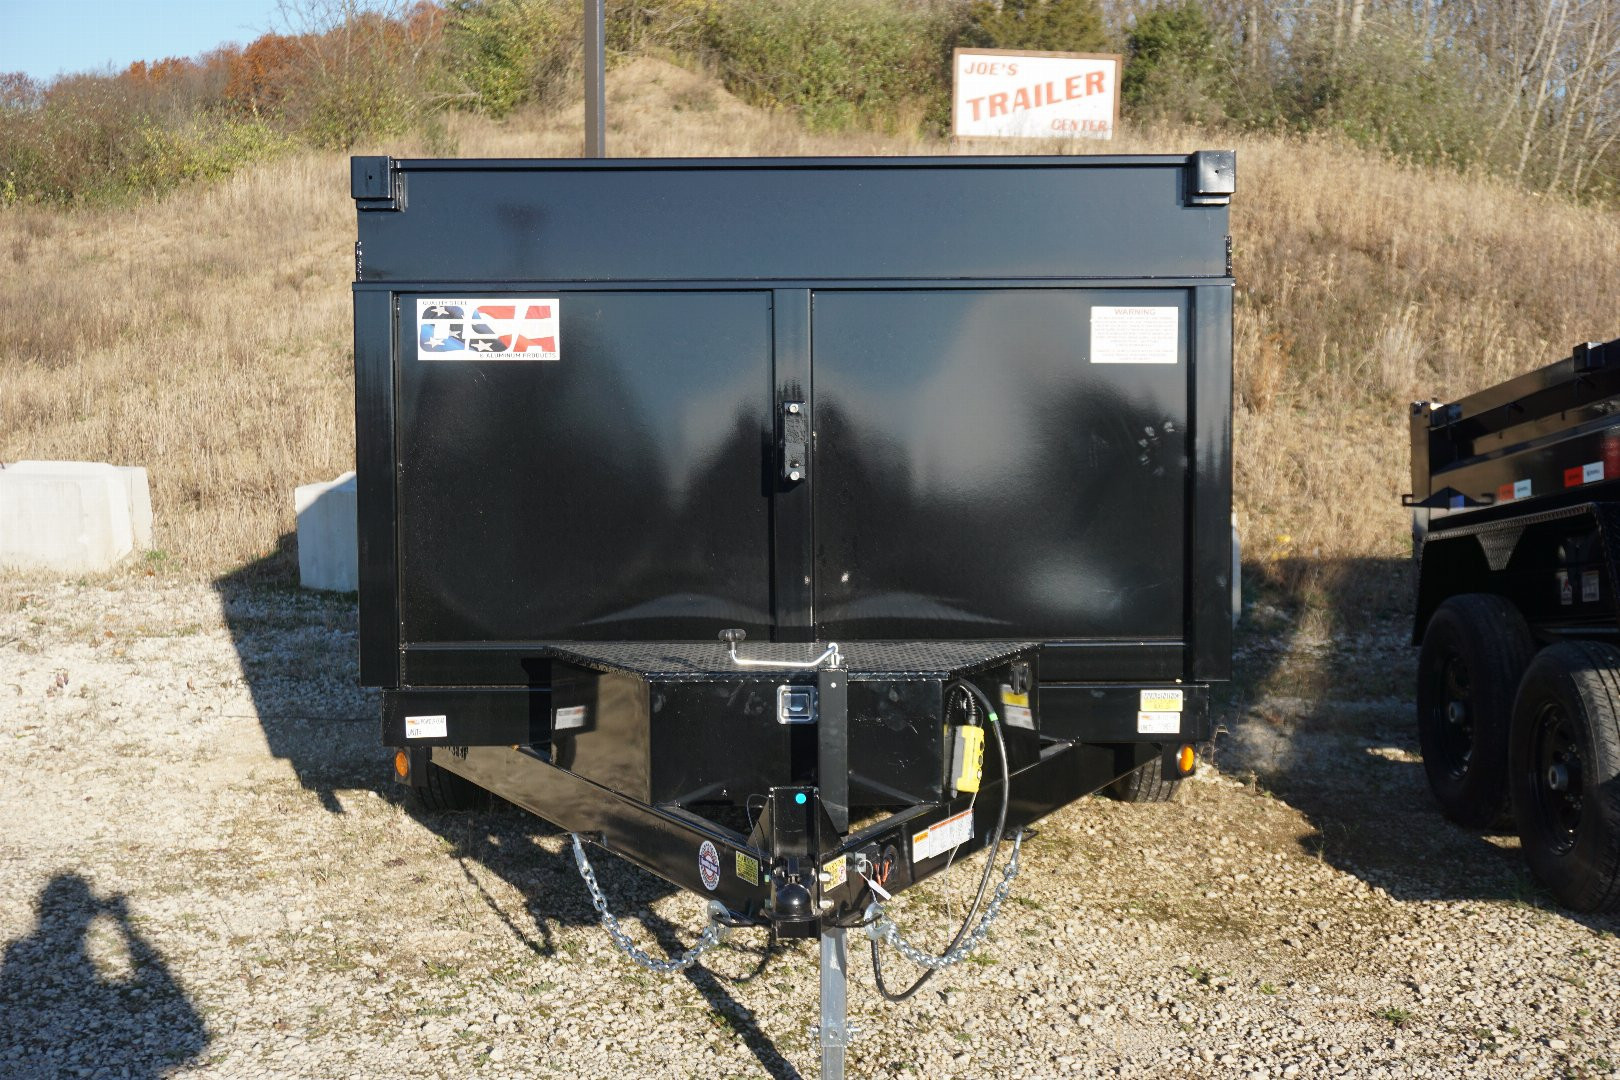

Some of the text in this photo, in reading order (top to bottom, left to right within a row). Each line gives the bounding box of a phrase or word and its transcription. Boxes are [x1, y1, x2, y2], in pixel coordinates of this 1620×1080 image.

[964, 61, 1018, 76] JOE'S
[966, 70, 1106, 121] TRAILER
[1051, 118, 1109, 131] CENTER
[419, 305, 557, 352] USA
